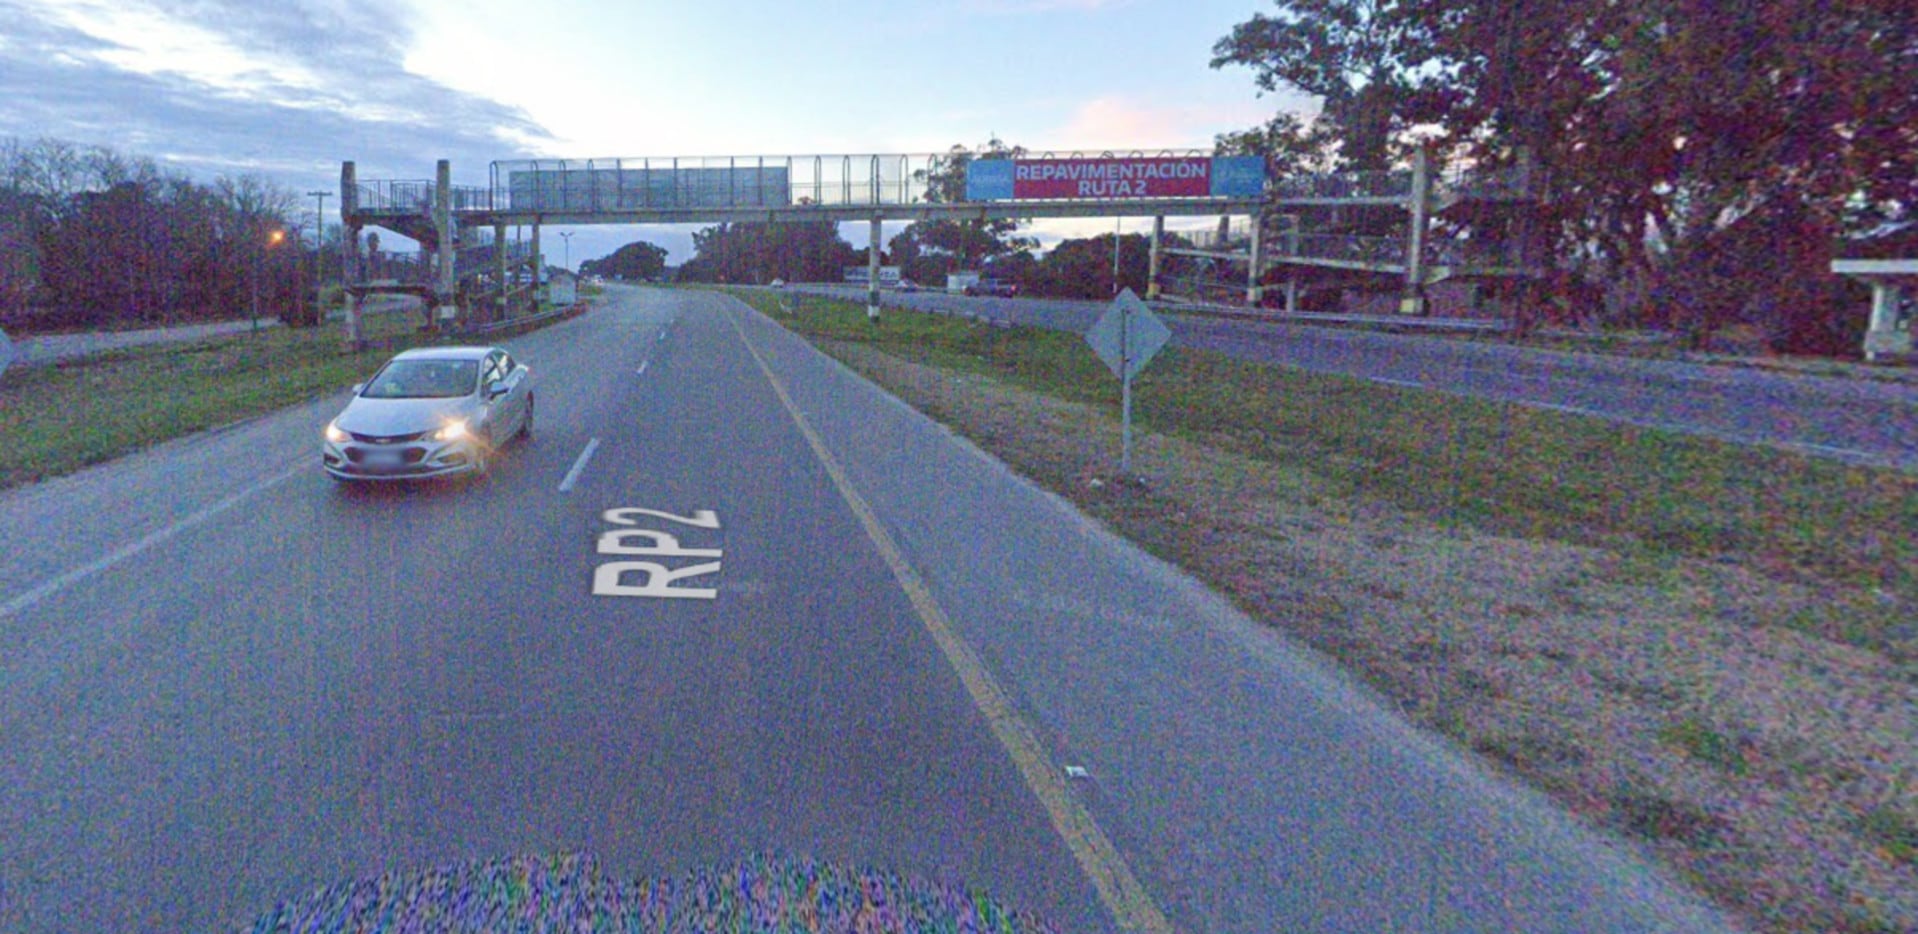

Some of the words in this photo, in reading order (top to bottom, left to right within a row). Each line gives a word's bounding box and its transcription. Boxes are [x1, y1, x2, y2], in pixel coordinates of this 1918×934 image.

[1016, 159, 1206, 180] REPAVIMENTACIÓN
[1078, 180, 1131, 196] RUTA
[1135, 180, 1147, 195] 2
